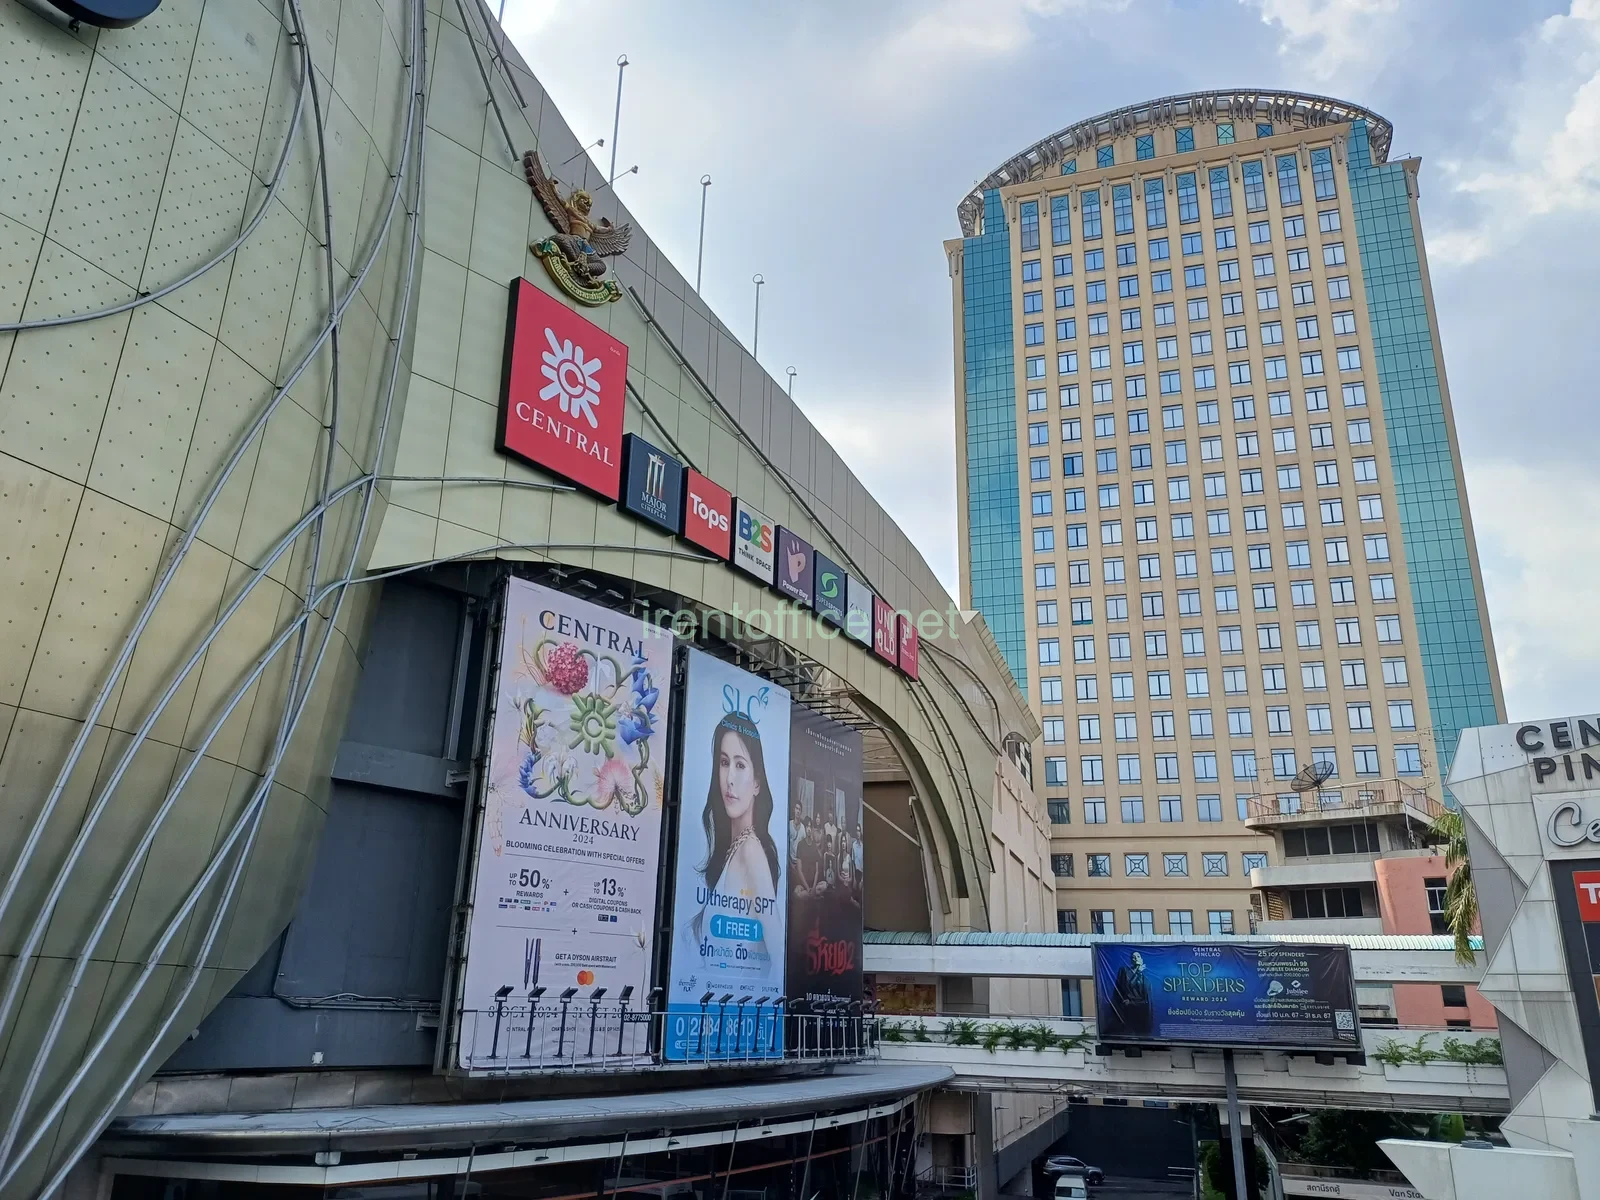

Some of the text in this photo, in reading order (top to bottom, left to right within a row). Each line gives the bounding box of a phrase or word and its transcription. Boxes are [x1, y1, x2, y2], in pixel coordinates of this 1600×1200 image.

[515, 401, 614, 467] CENTRAL
[640, 502, 667, 521] CINEPLEX
[641, 491, 667, 513] MAJOR
[689, 491, 728, 532] Tops
[738, 509, 772, 553] B2S
[738, 547, 772, 572] THINK SPACE
[781, 579, 809, 601] Power Buy
[877, 604, 894, 634] UNI
[538, 609, 649, 661] CENTRAL
[877, 628, 895, 656] QLO
[721, 684, 761, 725] SLC
[518, 807, 640, 842] ANNIVERSARY
[572, 833, 594, 845] 2024
[505, 839, 646, 866] BLOOMING CELEBRATION WITH SPECIAL OFFERS
[515, 890, 544, 899] REWARDS
[588, 897, 628, 907] DIGITAL COUPONS
[696, 886, 776, 916] Ultherapy SPT
[1579, 883, 1600, 904] T
[579, 902, 593, 910] CASH
[592, 904, 615, 912] COUPONS
[618, 906, 631, 914] CASH
[716, 917, 758, 939] 1 FREE 1
[590, 955, 618, 963] AIRSTRAIT
[1177, 962, 1212, 978] TOP
[1163, 977, 1246, 993] SPENDERS
[488, 1005, 495, 1018] 8
[500, 1005, 527, 1018] OCT
[1306, 1184, 1340, 1195] สถานีรถตู้
[1388, 1188, 1406, 1198] Van
